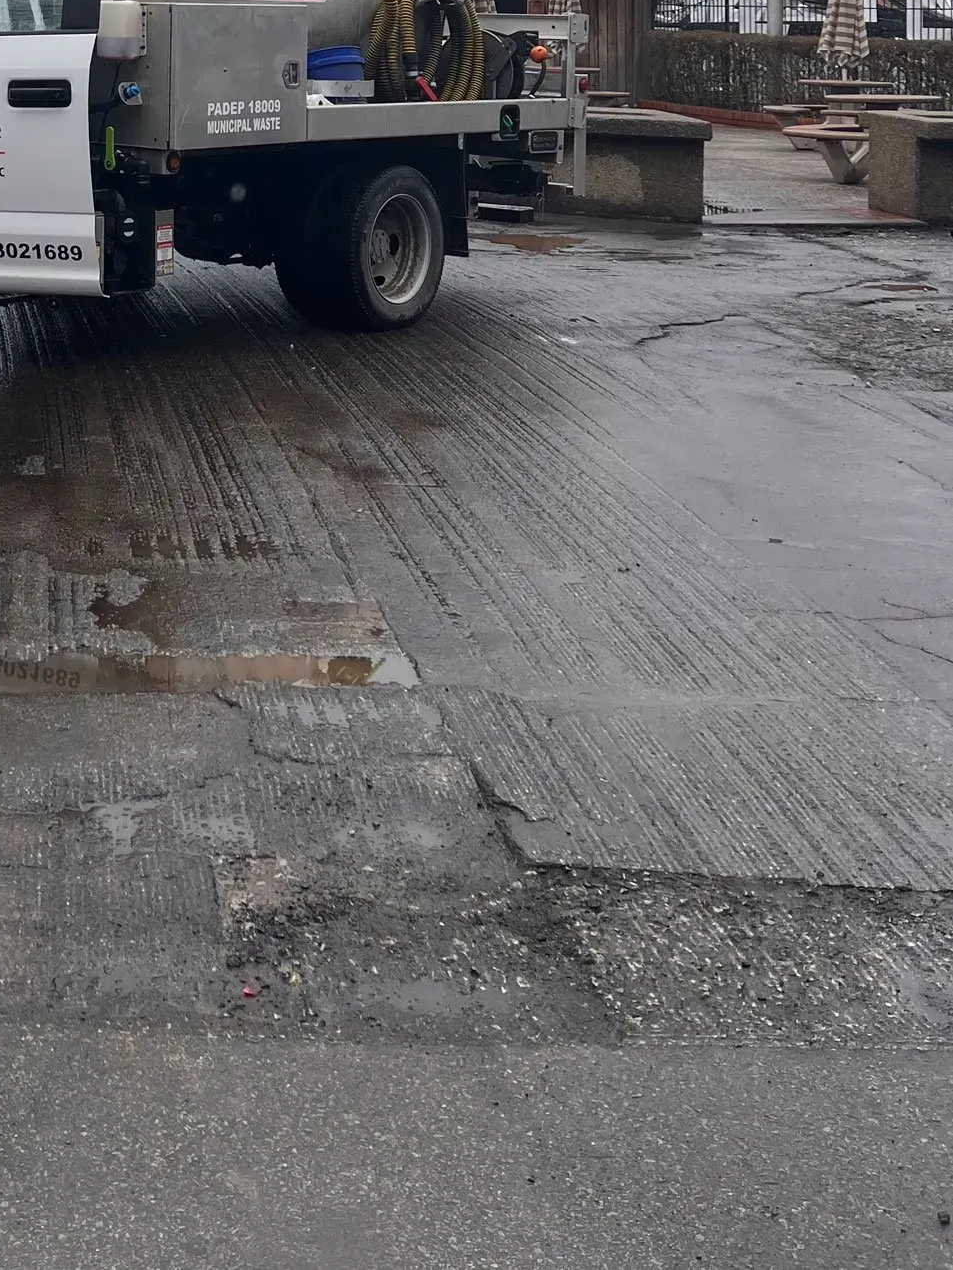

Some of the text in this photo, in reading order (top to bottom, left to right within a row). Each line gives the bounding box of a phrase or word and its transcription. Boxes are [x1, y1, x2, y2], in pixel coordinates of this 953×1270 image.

[207, 99, 281, 116] PADEP 18009
[207, 116, 281, 134] MUNICIPAL WASTE
